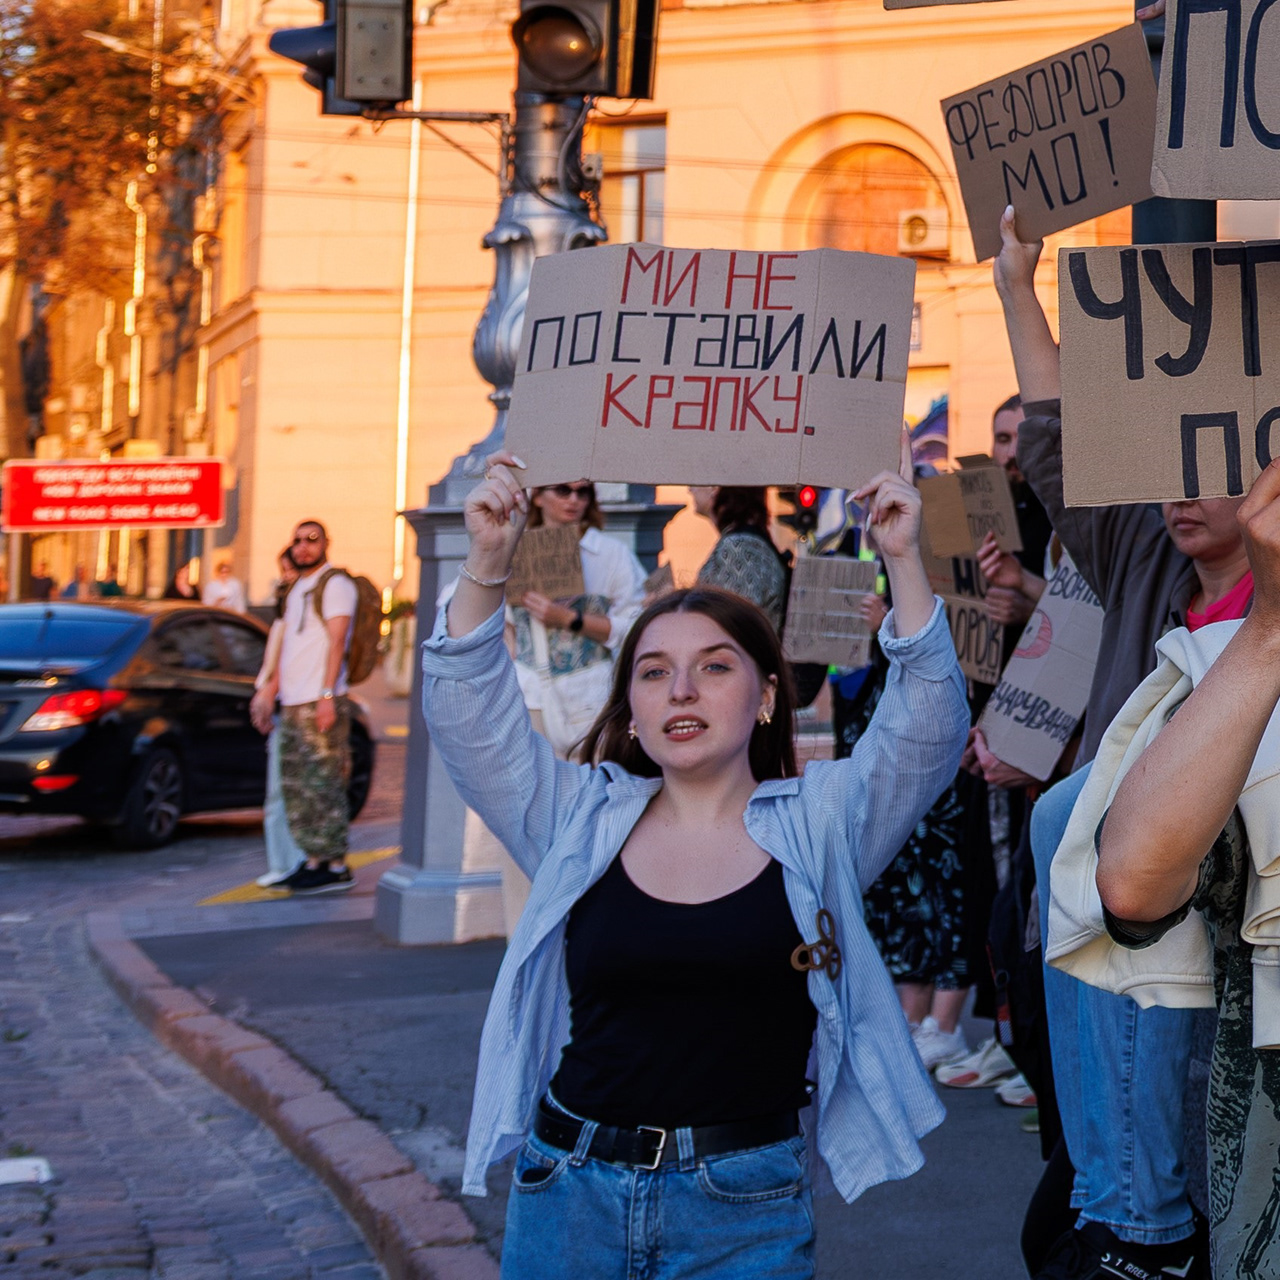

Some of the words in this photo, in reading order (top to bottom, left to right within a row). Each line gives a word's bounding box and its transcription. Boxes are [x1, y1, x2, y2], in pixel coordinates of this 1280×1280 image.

[945, 43, 1126, 160] ФЕДОРОВ
[621, 247, 701, 307] МИ
[725, 252, 798, 310] НЕ
